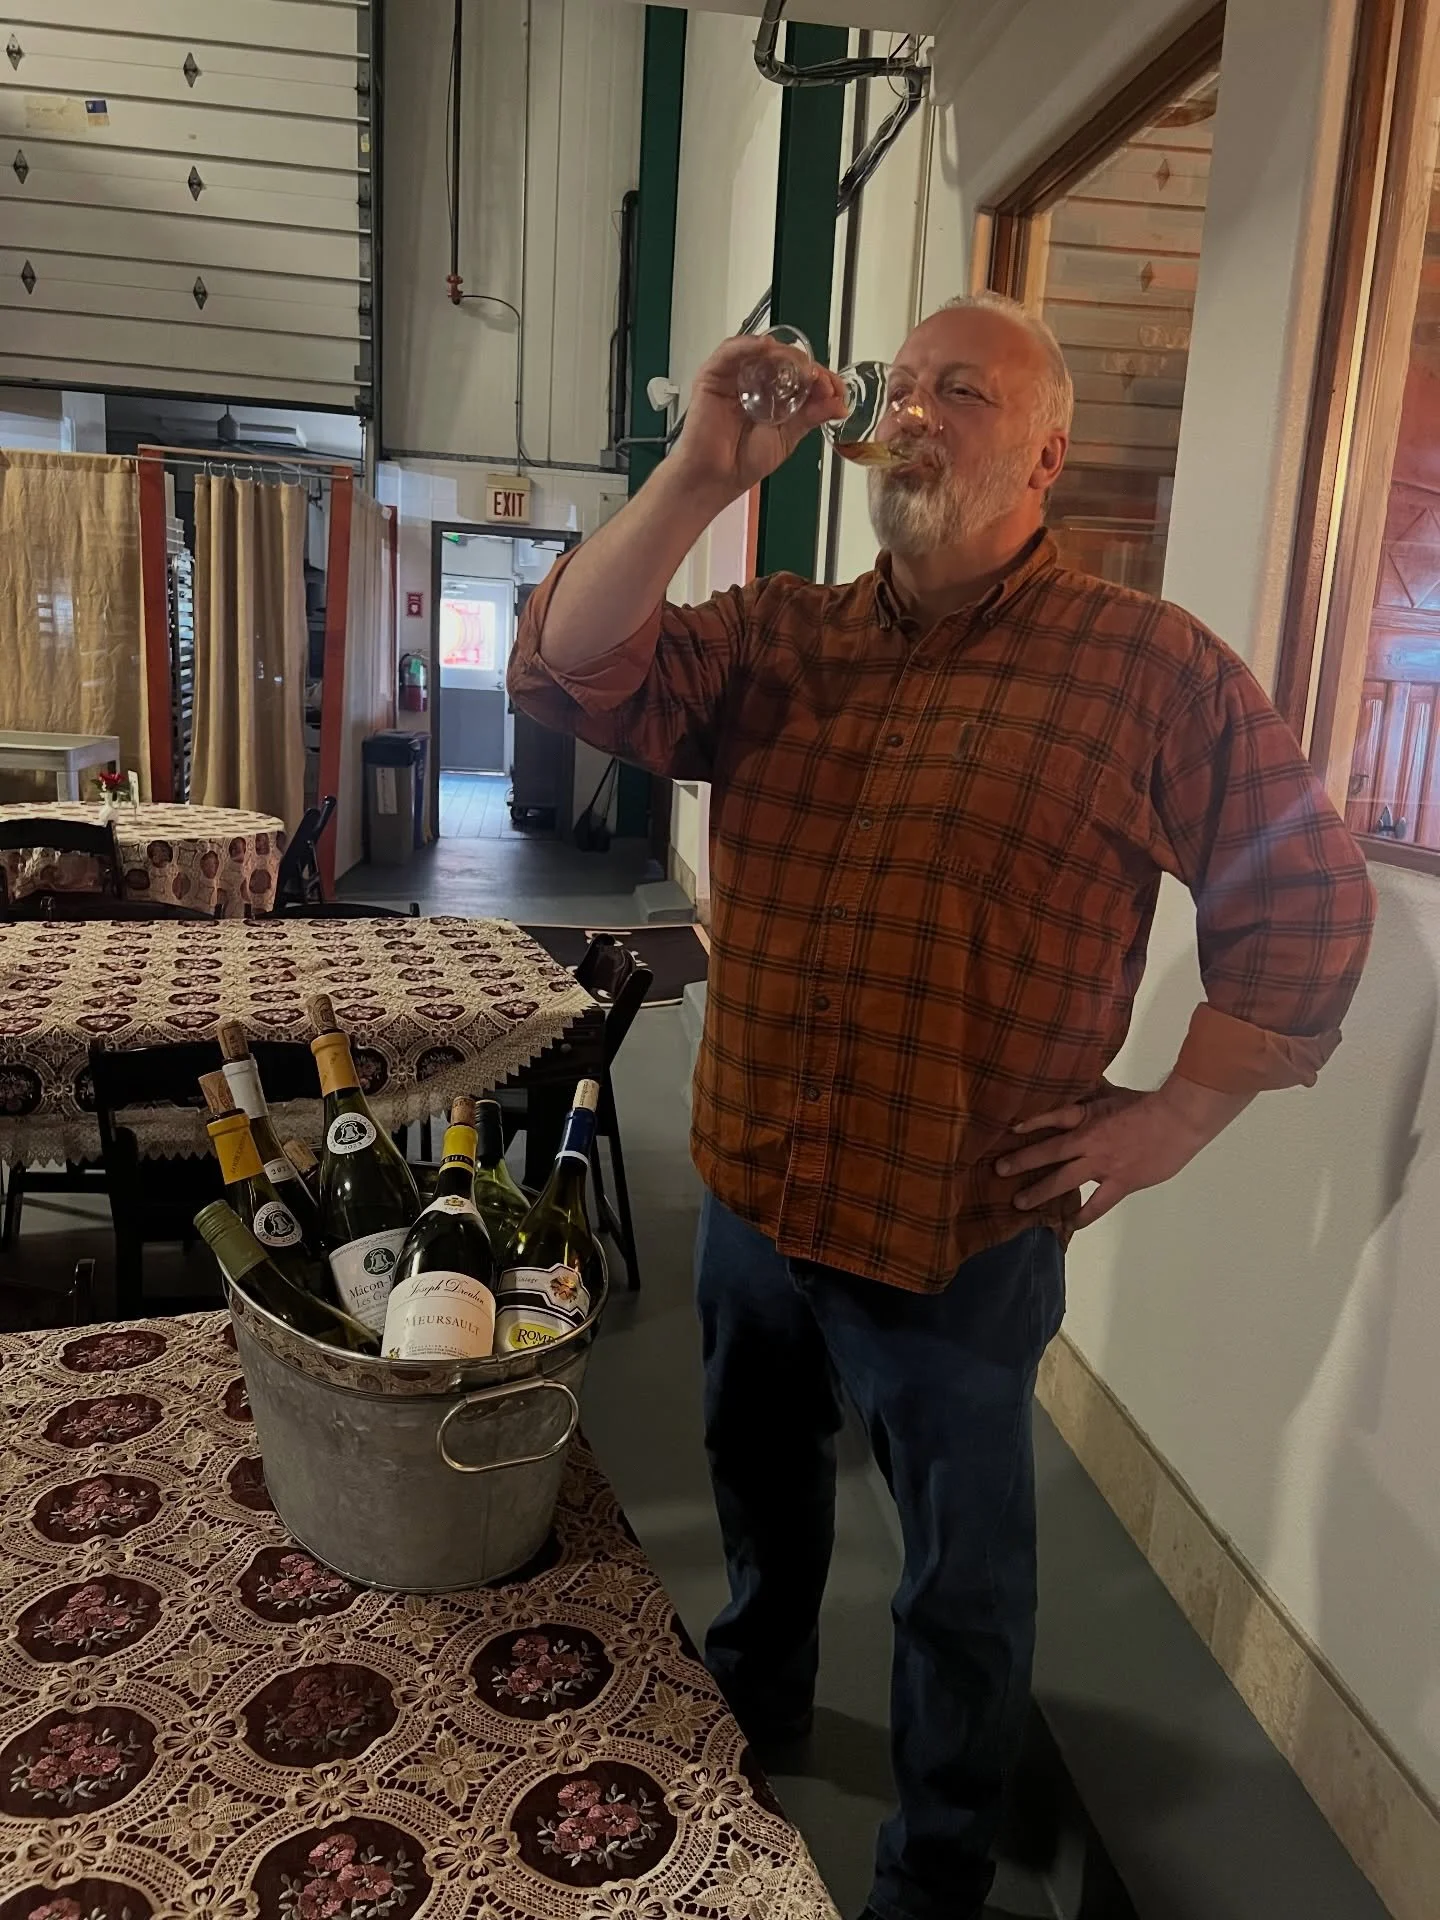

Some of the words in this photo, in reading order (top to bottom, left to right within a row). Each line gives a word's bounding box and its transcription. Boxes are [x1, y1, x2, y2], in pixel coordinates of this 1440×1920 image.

[494, 491, 525, 517] EXIT
[408, 1278, 444, 1298] Joseph
[443, 1278, 485, 1305] Drouhin
[404, 1315, 480, 1336] MEURSAULT
